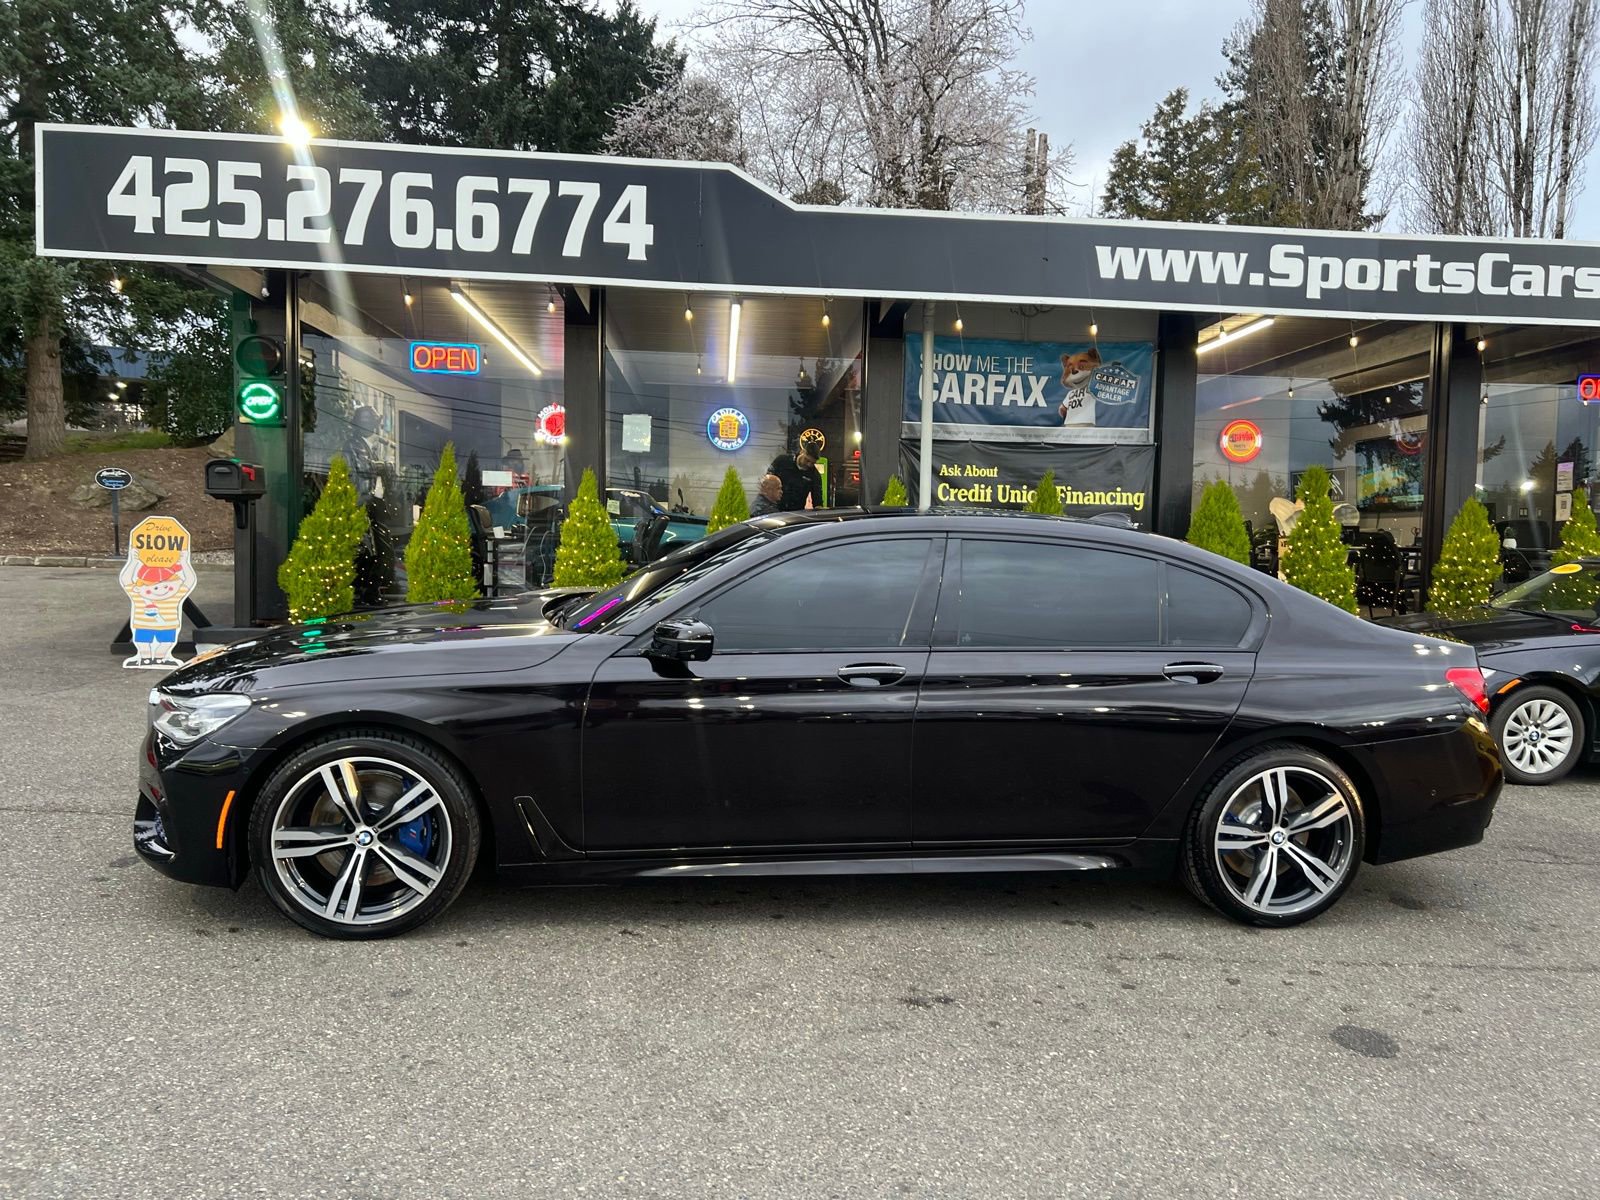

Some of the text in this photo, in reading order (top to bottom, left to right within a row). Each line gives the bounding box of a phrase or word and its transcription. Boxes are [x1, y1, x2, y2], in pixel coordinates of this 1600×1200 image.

[107, 155, 654, 261] 425.276.6774
[1095, 243, 1600, 299] www.SportsCars
[414, 346, 476, 370] OPEN
[920, 353, 1034, 374] HOW ME THE
[1095, 372, 1136, 389] CARFAX
[1094, 383, 1131, 397] ADVANTAGE
[1097, 391, 1122, 403] DEALER
[711, 409, 746, 425] CADILLAC
[714, 437, 742, 449] SERVICE
[939, 464, 998, 478] Ask About
[937, 482, 1145, 511] Credit Unio Financing
[145, 522, 173, 532] Drive
[136, 533, 185, 551] SLOW
[146, 554, 174, 564] please
